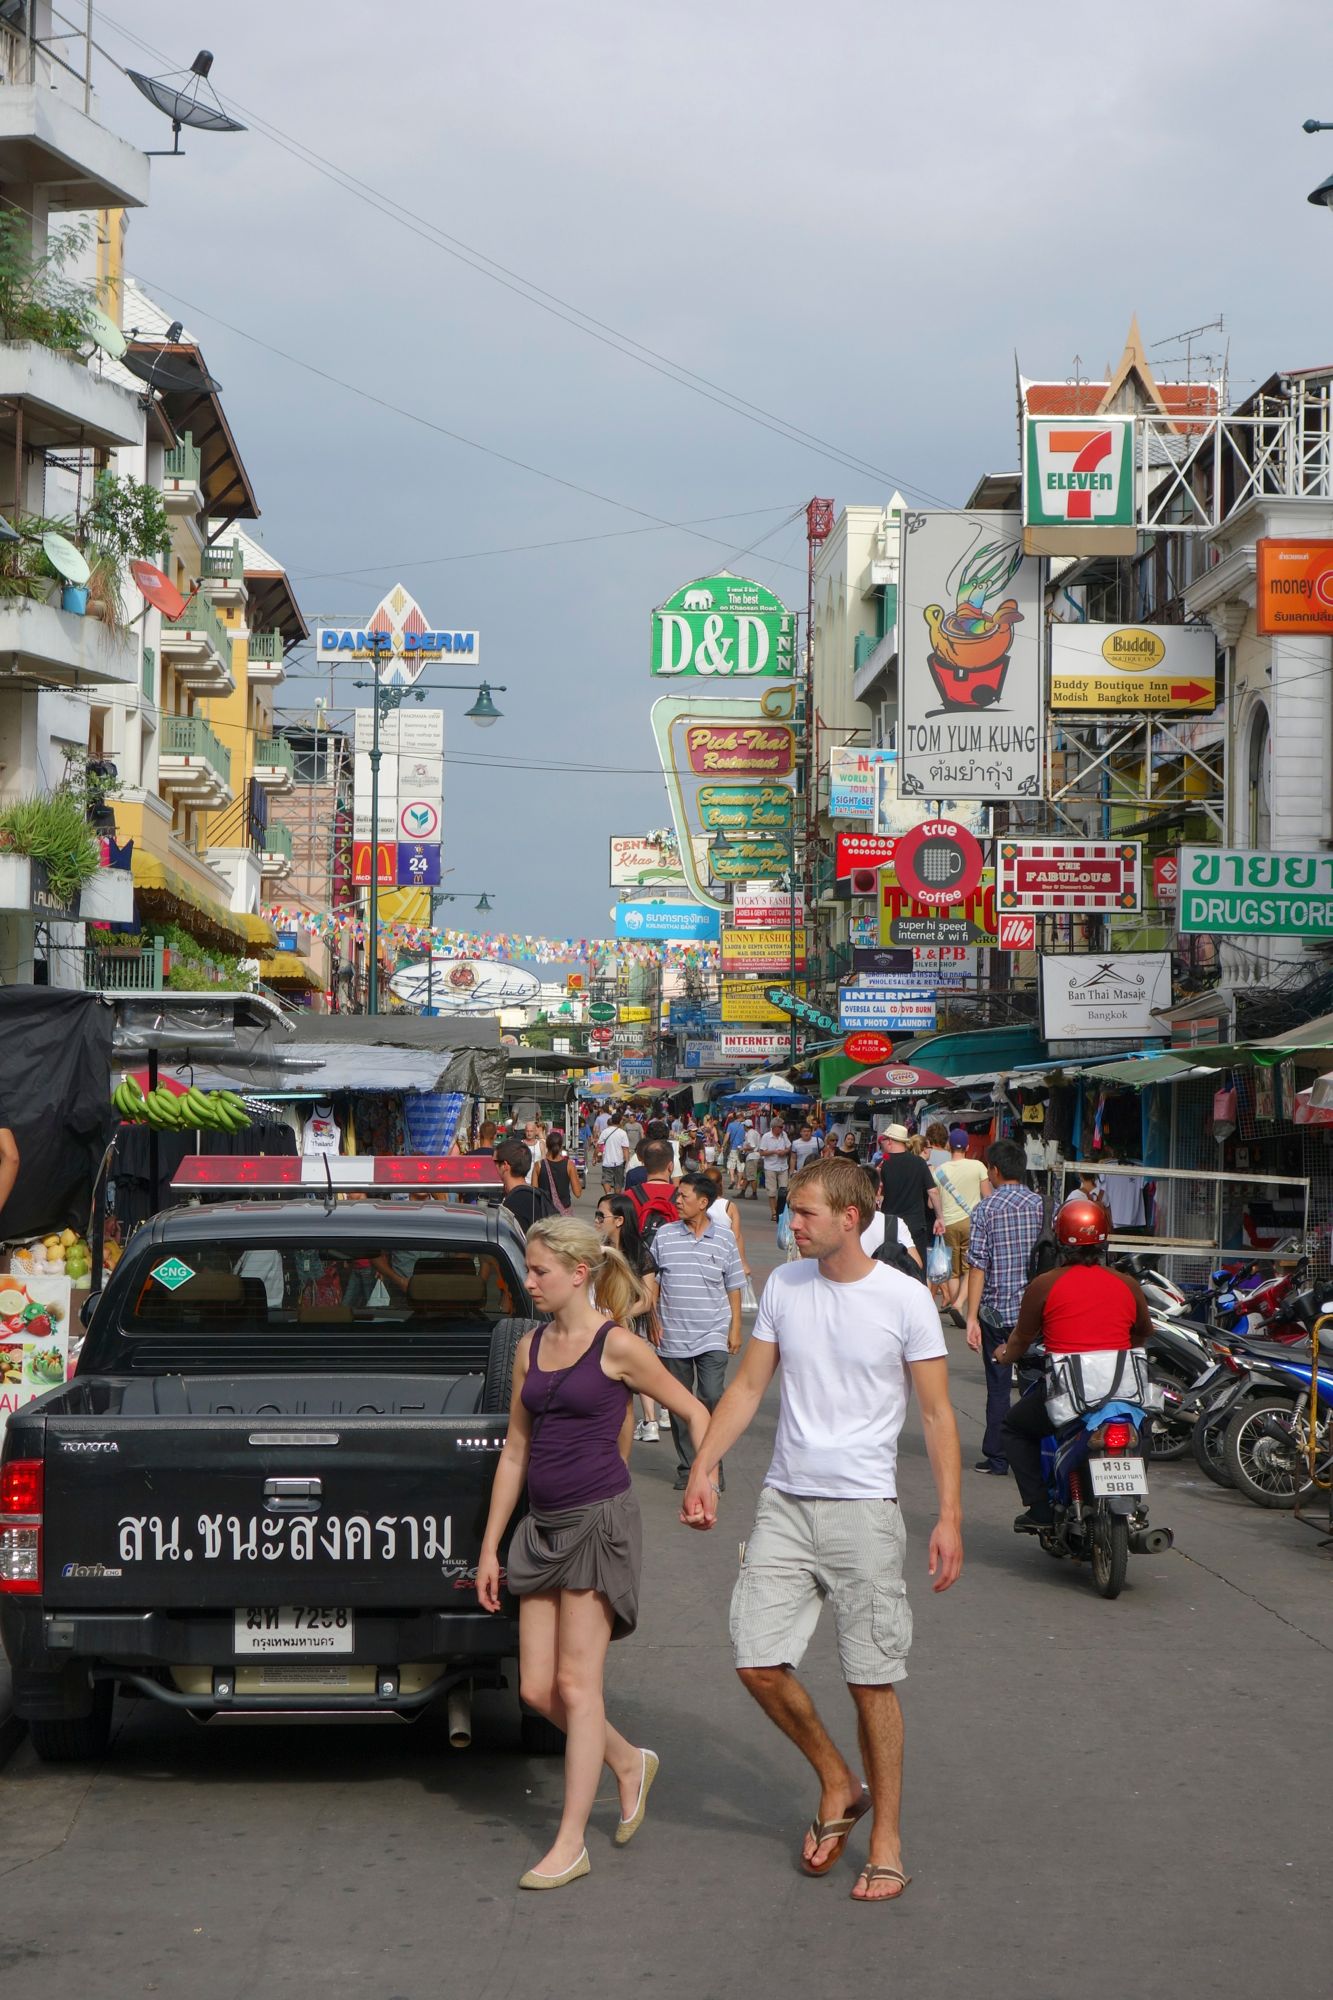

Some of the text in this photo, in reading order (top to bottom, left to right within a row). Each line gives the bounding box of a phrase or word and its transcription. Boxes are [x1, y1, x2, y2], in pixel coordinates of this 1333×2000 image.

[1271, 580, 1314, 598] money
[728, 594, 758, 604] The best
[404, 632, 474, 653] DERM
[657, 614, 769, 675] D&D
[777, 616, 792, 672] INN
[1113, 636, 1155, 655] Buddy
[1054, 680, 1168, 692] Buddy Boutique Inn
[1053, 692, 1170, 704] Modish Bangkok Hotel
[908, 725, 1035, 752] TOM YUM KUNG
[704, 752, 780, 770] Restaurant
[840, 774, 868, 782] WORLD
[930, 760, 1013, 790] ต้มยำกุ้ง
[836, 796, 858, 805] SIGHT
[708, 808, 785, 828] Beauty Salon
[922, 824, 958, 836] true
[614, 840, 660, 852] CENTE
[409, 858, 428, 872] 24
[614, 852, 654, 867] Khao
[1057, 862, 1080, 870] THE
[1026, 872, 1111, 883] FABULOUS
[736, 896, 802, 905] VICKY'S FASHIN
[918, 890, 962, 904] coffee
[1191, 898, 1333, 927] DRUGSTORE
[646, 914, 710, 924] ธนาคารกรุงไทย
[898, 922, 966, 931] super hi speed
[725, 934, 758, 942] SUNNY
[898, 932, 968, 940] internet & wi fi
[1002, 920, 1032, 947] illy
[926, 950, 936, 960] &
[846, 992, 931, 1000] INTERNET
[1068, 988, 1146, 1002] Ban Thai Masaje
[1088, 1010, 1128, 1022] Bangkok
[898, 1019, 932, 1028] LAUNDRY
[614, 1034, 643, 1042] TATTOO
[725, 1036, 774, 1046] INTERNET
[777, 1036, 802, 1046] CAE
[724, 1046, 766, 1054] OVERSEA CALL FAX
[159, 1267, 186, 1276] CNG
[61, 1442, 120, 1452] TOYOTA
[456, 1438, 507, 1452] HILU
[1106, 1482, 1134, 1492] 988
[118, 1514, 452, 1561] สน.ชนะสงคราม
[293, 1608, 348, 1629] 7258
[252, 1638, 334, 1651] กรุงเทพมหานคร
